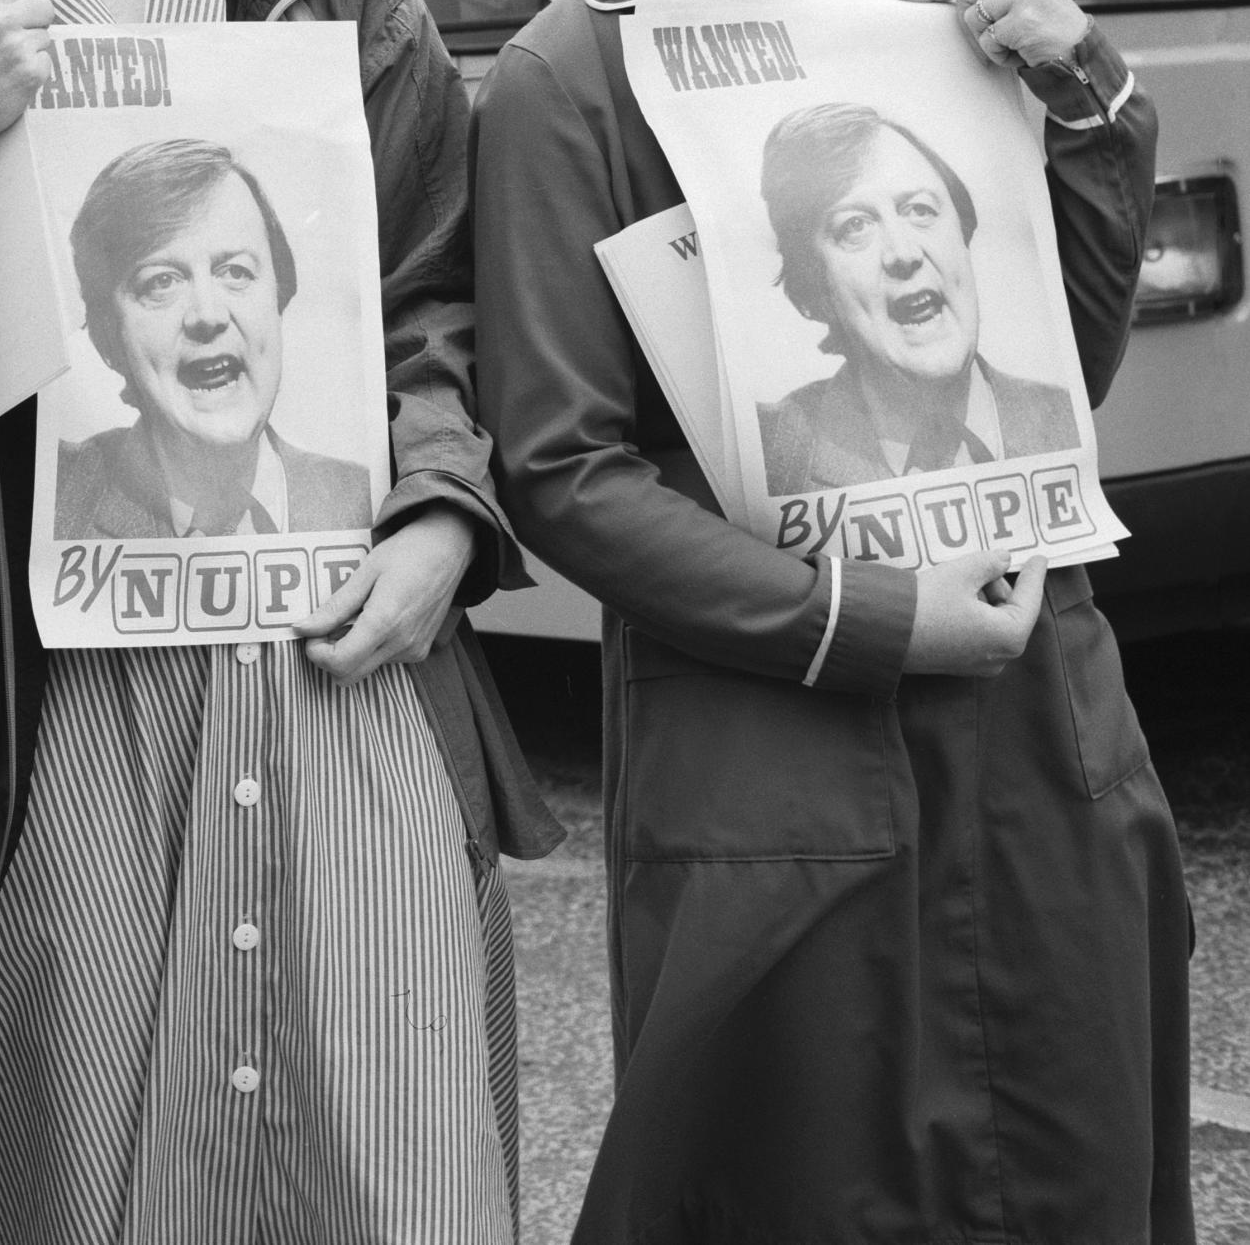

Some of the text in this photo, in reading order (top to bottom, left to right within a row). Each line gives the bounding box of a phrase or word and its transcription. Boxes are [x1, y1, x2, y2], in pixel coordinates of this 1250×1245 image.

[28, 37, 172, 109] ANTED!
[652, 20, 807, 92] WANTED!
[776, 479, 1082, 561] BY NUPE
[53, 544, 124, 613] BY
